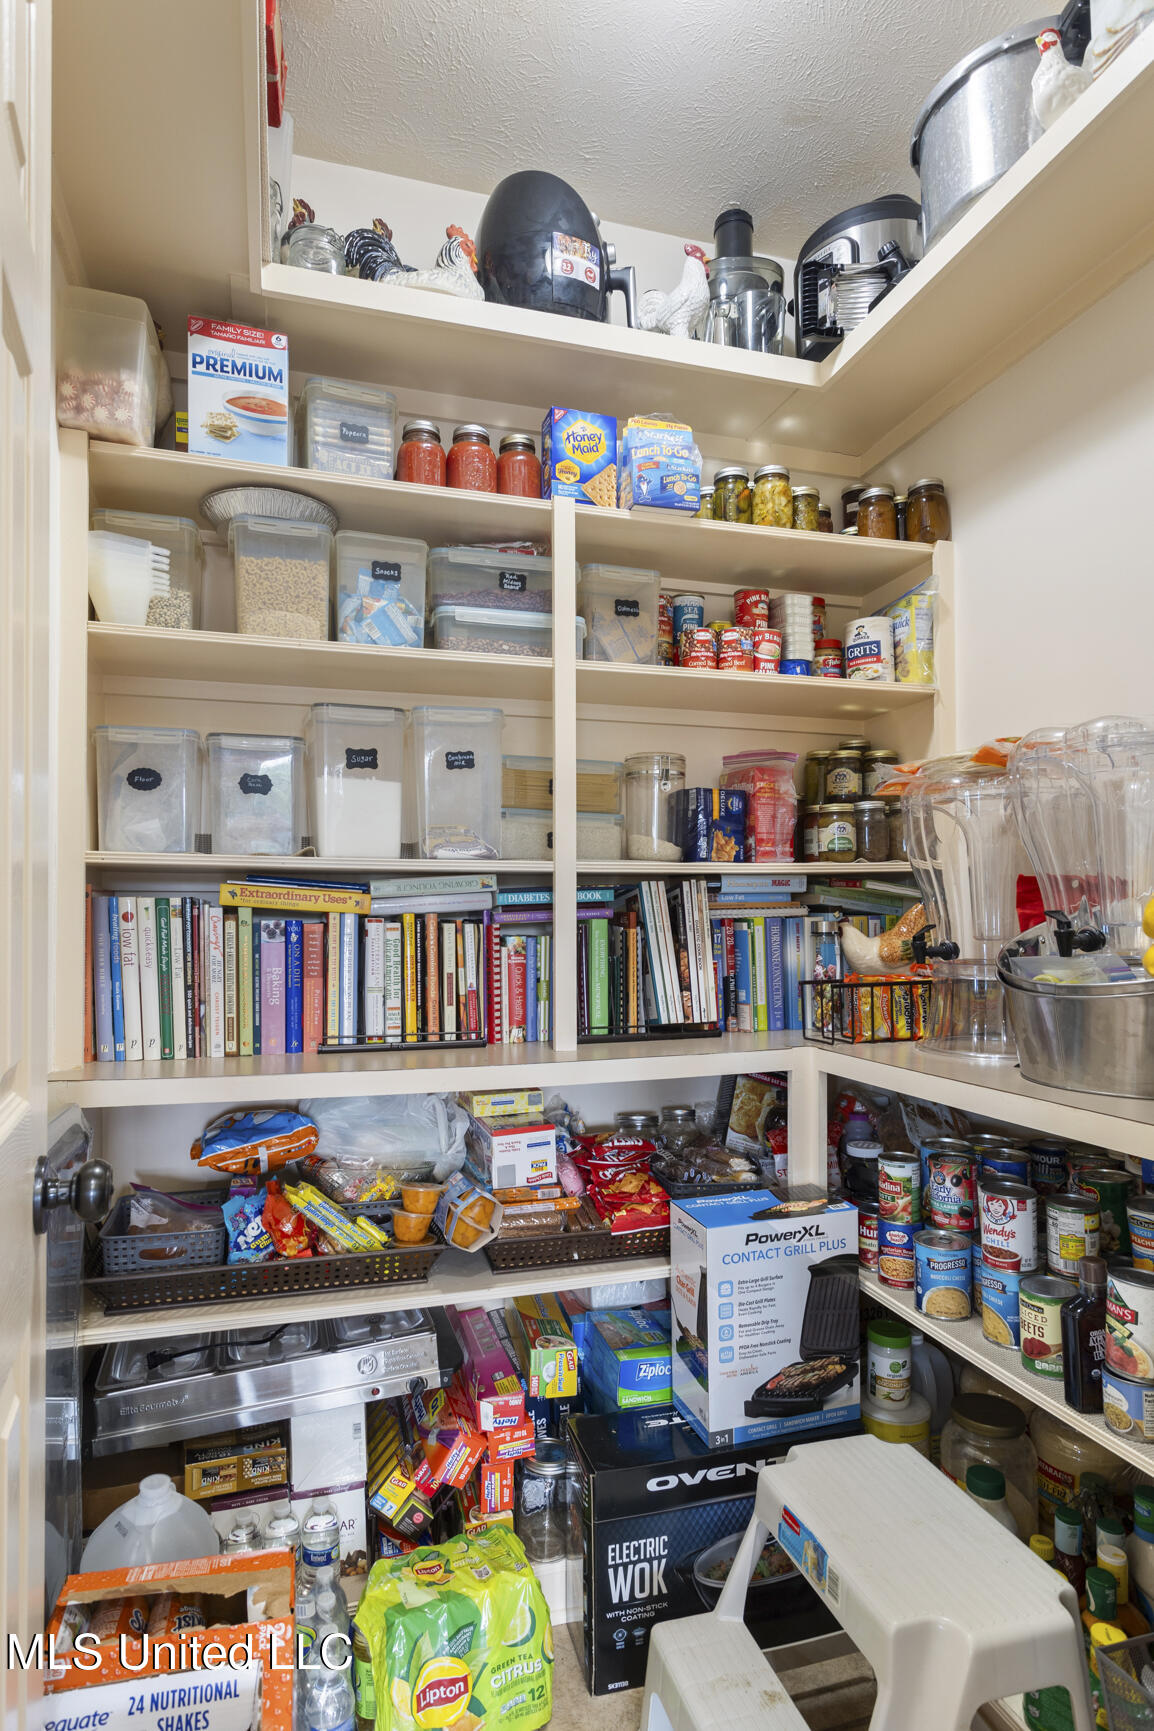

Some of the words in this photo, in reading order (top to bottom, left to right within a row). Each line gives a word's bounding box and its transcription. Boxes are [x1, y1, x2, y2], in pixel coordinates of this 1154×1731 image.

[211, 322, 242, 335] FAMILY
[191, 352, 284, 384] PREMIUM
[564, 430, 602, 446] Honey
[572, 442, 600, 455] Maid
[632, 446, 660, 458] Lunch
[662, 444, 689, 458] To-Go
[664, 474, 680, 482] Lunch
[374, 568, 398, 576] Snacks
[746, 594, 760, 605] PINK
[683, 606, 698, 614] SEA
[848, 644, 878, 658] GRITS
[760, 662, 775, 670] PINK
[350, 754, 374, 764] Sugar
[772, 879, 791, 887] MAGIC
[239, 888, 320, 904] Extraordinary
[508, 892, 550, 903] DIABETES
[122, 928, 134, 948] low
[714, 934, 721, 943] 17
[174, 948, 182, 964] Low
[294, 944, 300, 957] ON
[123, 952, 136, 967] fat
[515, 966, 523, 986] Quick
[270, 967, 282, 1005] Baking
[514, 996, 523, 1021] Healthy
[931, 1182, 951, 1196] Early
[745, 1224, 826, 1246] PowerXL
[983, 1222, 1016, 1239] Wendy's
[986, 1238, 1010, 1248] CHILI
[722, 1247, 780, 1266] CONTACT
[784, 1243, 817, 1257] GRILL
[819, 1238, 847, 1252] PLUS
[930, 1258, 966, 1270] PROGRESSO
[566, 1351, 575, 1370] GLAD
[639, 1363, 672, 1378] Ziploc
[621, 1395, 652, 1404] SANDWICH
[493, 1417, 517, 1426] Hefty
[748, 1425, 766, 1434] CONTACT
[243, 1438, 281, 1451] KIND
[446, 1449, 459, 1468] Hefty
[251, 1465, 269, 1474] KIND
[414, 1463, 429, 1481] SARAN
[201, 1475, 220, 1484] KIND
[390, 1477, 407, 1488] GLAD
[466, 1524, 487, 1536] GLAD
[607, 1535, 669, 1566] ELECTRIC
[416, 1564, 441, 1575] Lipton
[608, 1559, 668, 1604] WOK
[606, 1609, 625, 1620] WITH
[626, 1602, 668, 1615] NON-STICK
[621, 1611, 655, 1623] COATING
[490, 1658, 515, 1674] GREEN
[518, 1653, 534, 1663] TEA
[490, 1658, 542, 1688] CITRUS
[128, 1695, 144, 1716] 24
[150, 1679, 240, 1712] NUTRITIONAL
[417, 1680, 465, 1708] Lipton
[527, 1685, 546, 1702] 12
[157, 1710, 210, 1731] SHAKES
